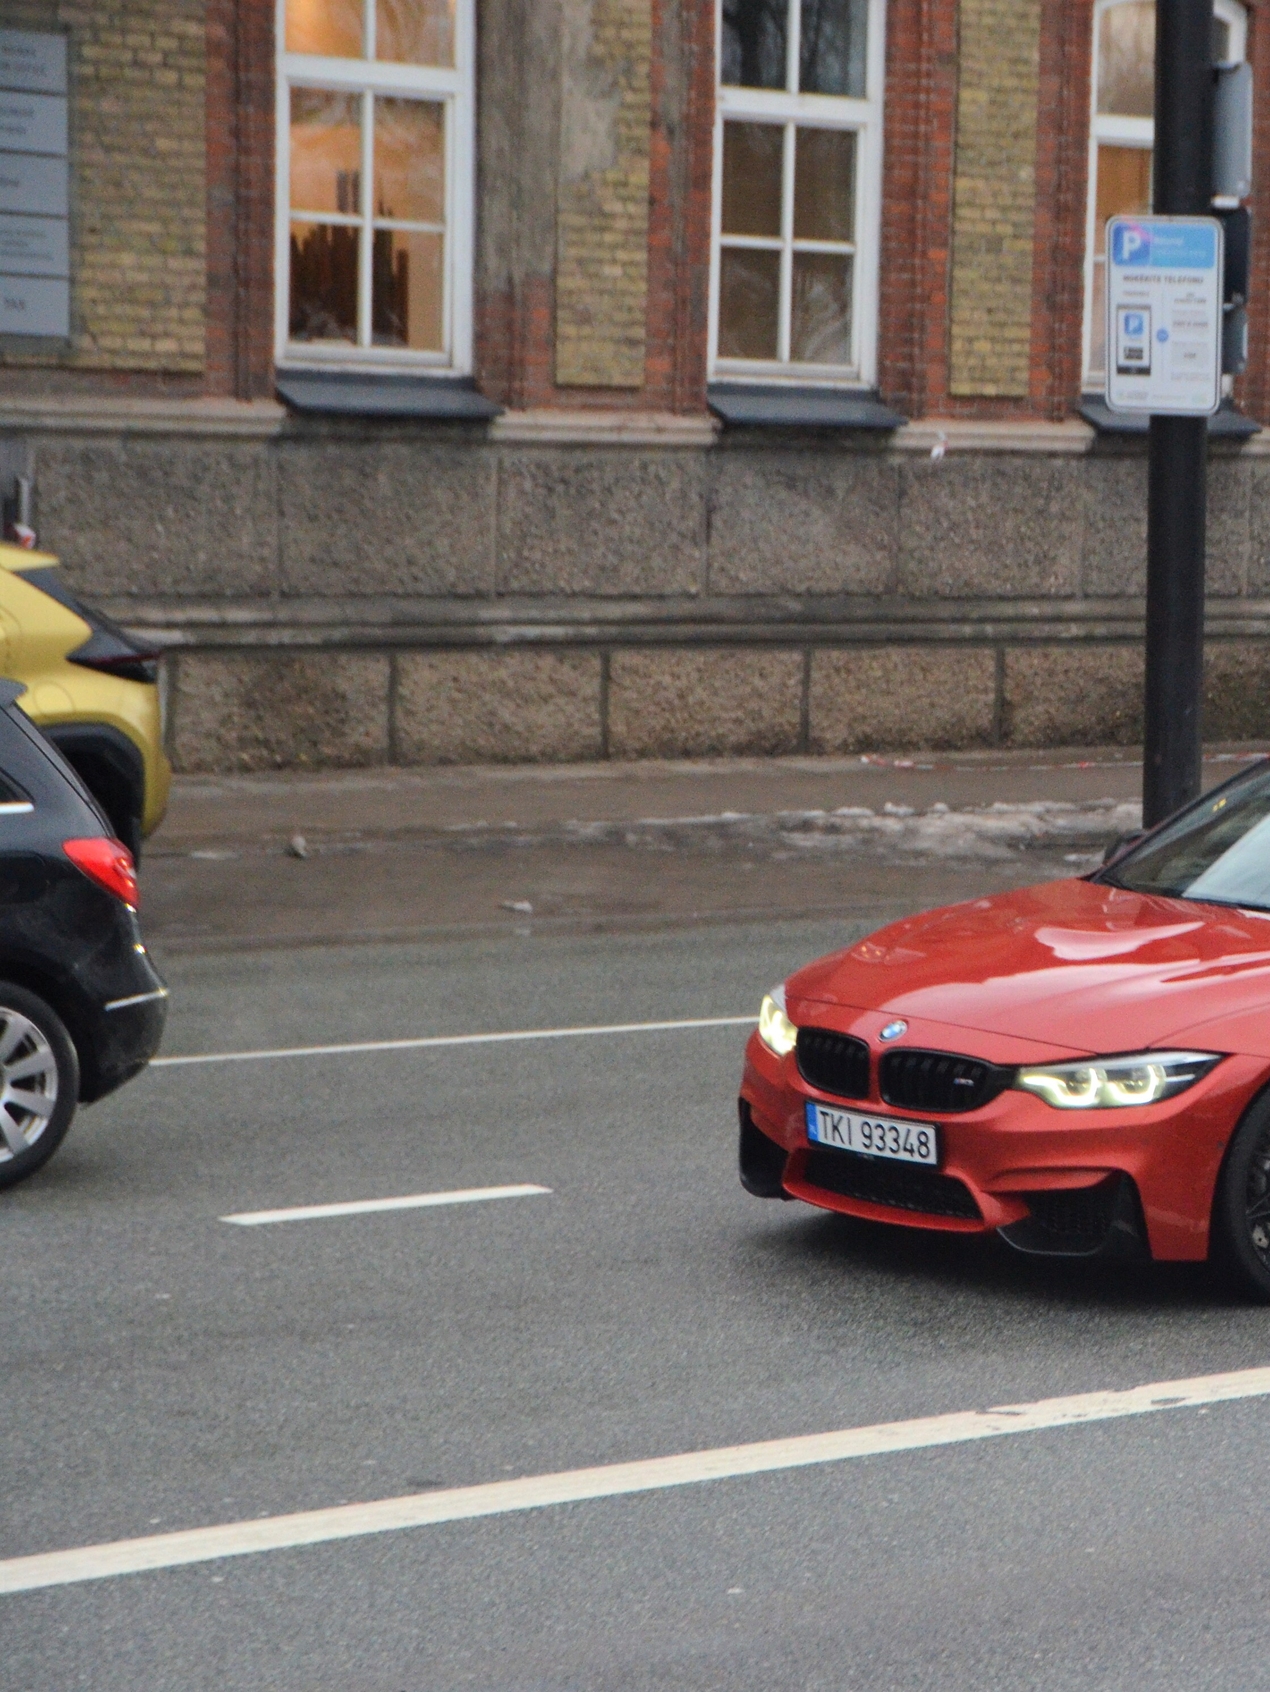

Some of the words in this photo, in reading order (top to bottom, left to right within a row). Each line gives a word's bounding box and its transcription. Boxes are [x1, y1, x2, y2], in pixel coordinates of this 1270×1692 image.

[1122, 231, 1141, 260] P
[820, 1110, 852, 1146] TKI
[861, 1121, 930, 1159] 93348
